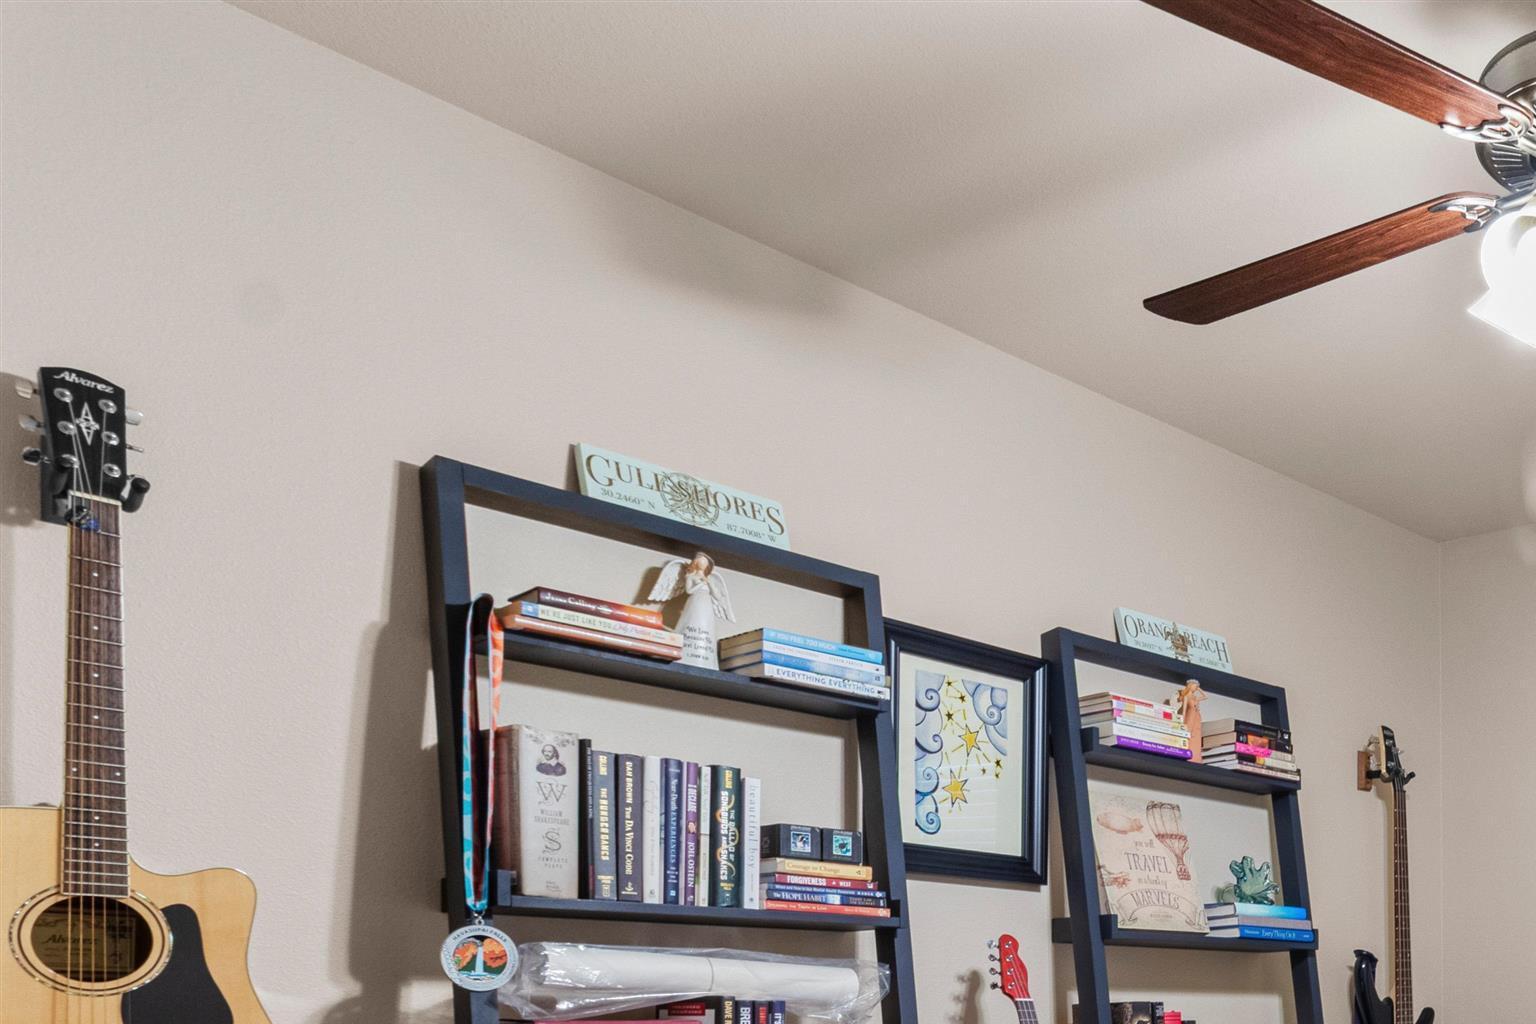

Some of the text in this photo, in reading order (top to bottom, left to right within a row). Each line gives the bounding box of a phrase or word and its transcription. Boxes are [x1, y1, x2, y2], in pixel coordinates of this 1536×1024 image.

[53, 370, 115, 394] Alvarez
[676, 479, 785, 537] SHORES
[1123, 613, 1175, 642] ORANG
[776, 667, 875, 695] EVERYTHING EVERYTHING
[599, 787, 608, 799] THE
[625, 761, 634, 803] DAN BROWN
[686, 788, 697, 813] DECLARE
[720, 790, 730, 834] SONGBIRDS
[748, 784, 759, 842] beautiful
[728, 821, 737, 853] BALLAD
[686, 841, 696, 888] JOEL OSTEEN
[720, 848, 730, 881] SNAKES
[1123, 851, 1172, 875] TRAVEL
[786, 875, 827, 887] FORGIVENESS
[839, 880, 852, 888] WEST
[781, 892, 803, 901] HOPE
[803, 893, 826, 903] HABIT
[724, 1000, 733, 1019] DAVE
